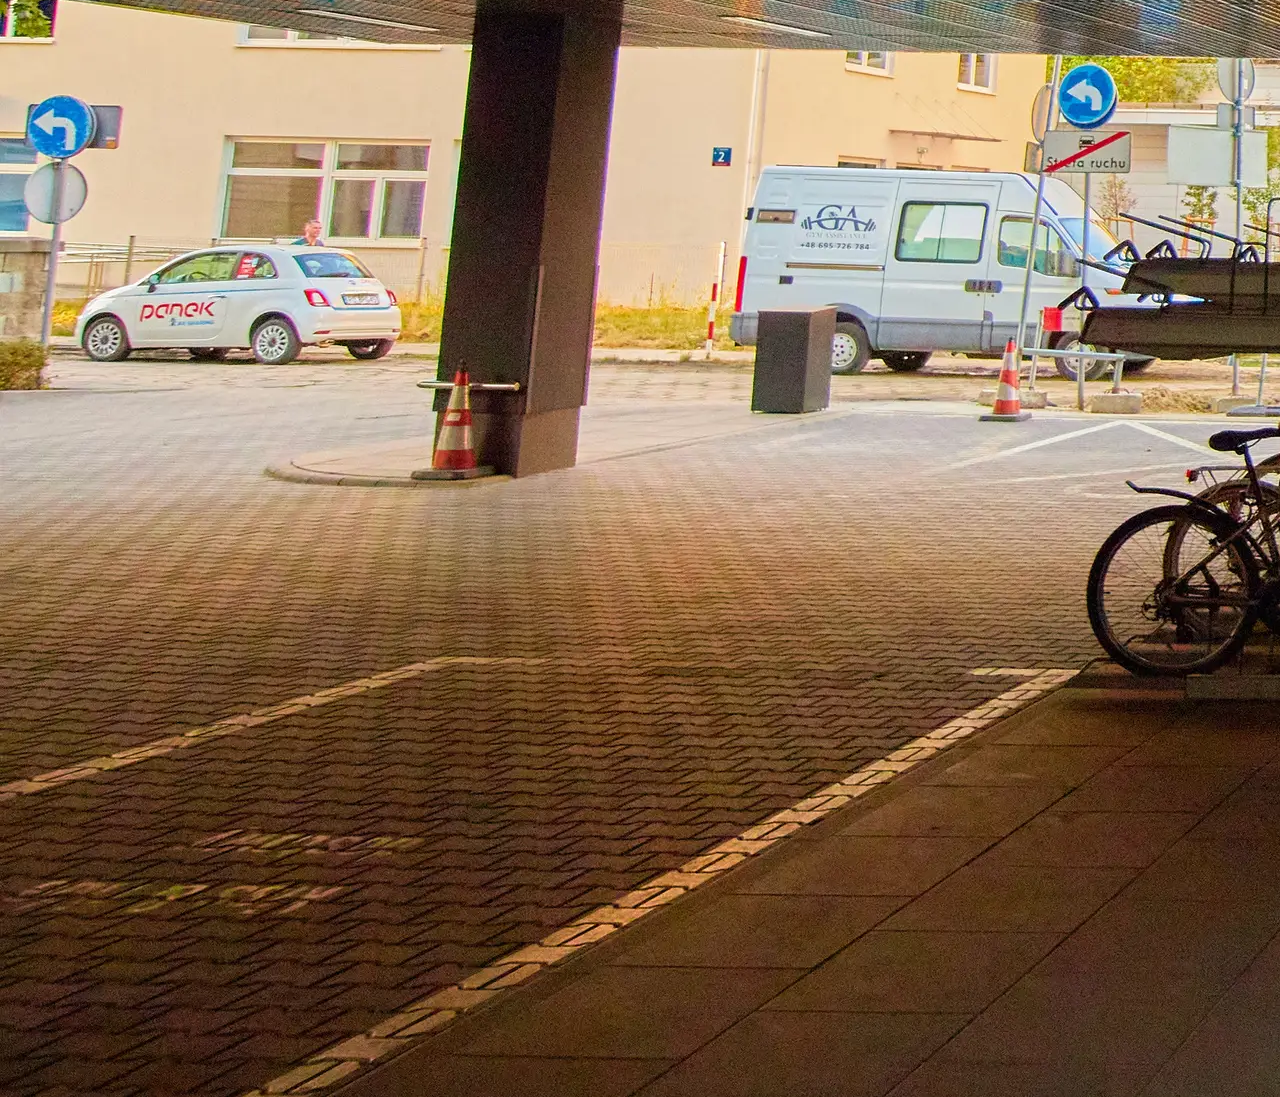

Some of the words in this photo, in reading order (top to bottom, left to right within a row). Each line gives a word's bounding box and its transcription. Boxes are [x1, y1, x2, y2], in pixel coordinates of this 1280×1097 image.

[718, 151, 725, 162] 2
[1090, 157, 1126, 168] ruchu
[836, 242, 852, 250] 726
[140, 301, 215, 322] panek
